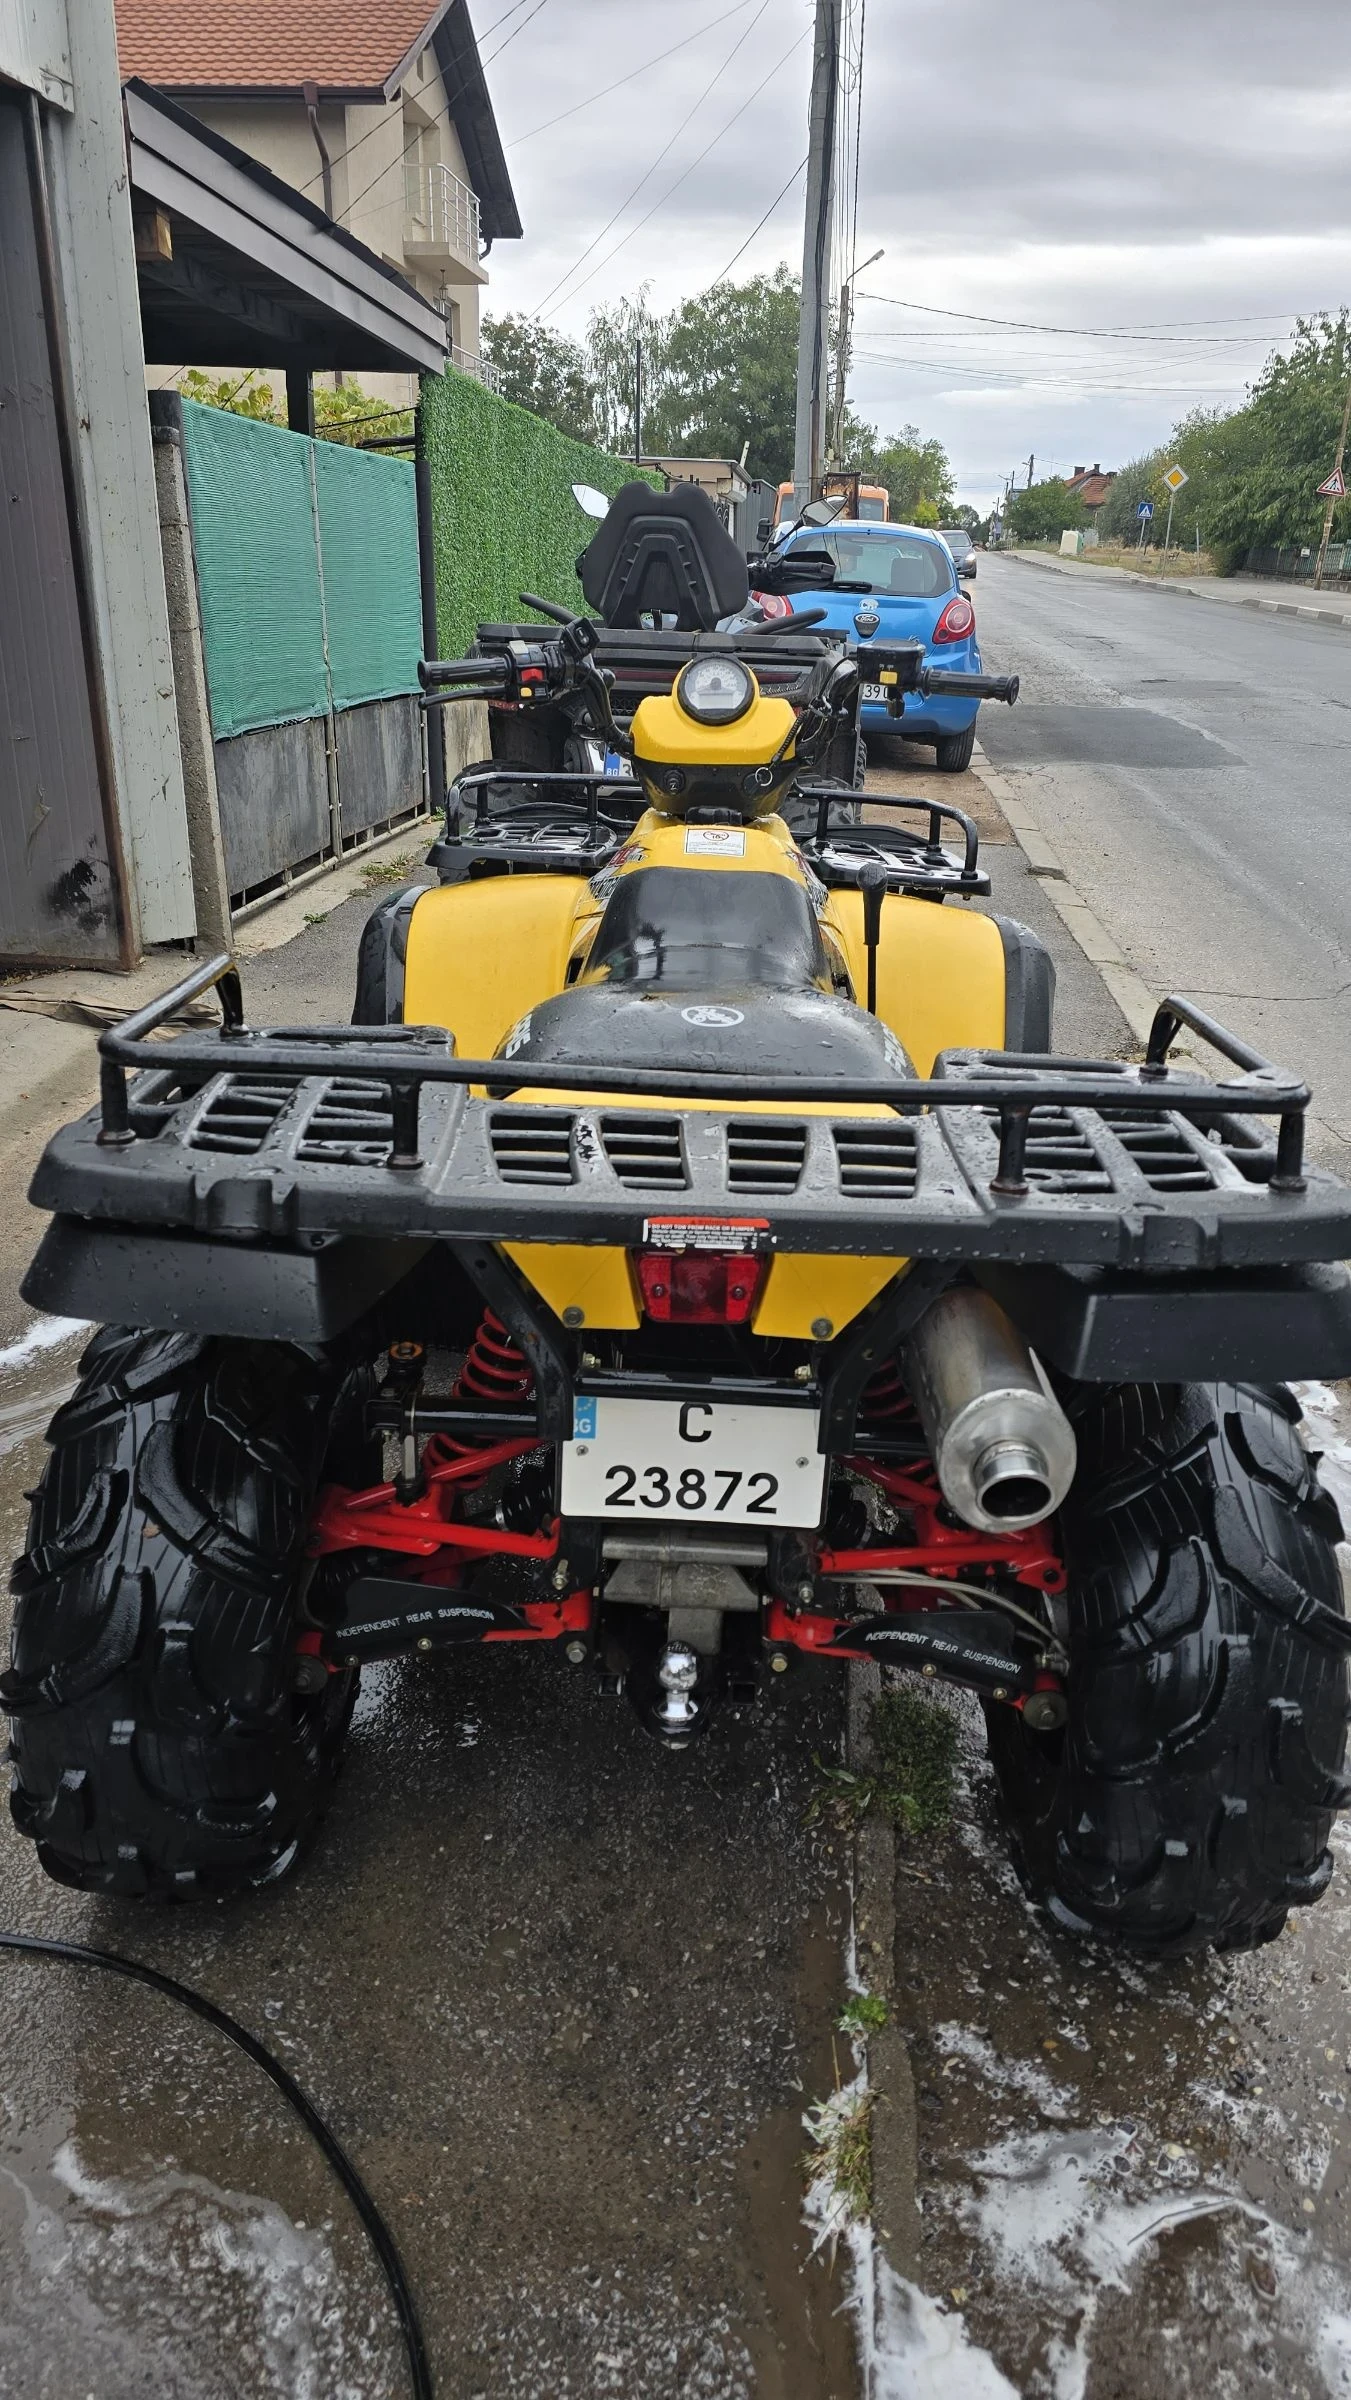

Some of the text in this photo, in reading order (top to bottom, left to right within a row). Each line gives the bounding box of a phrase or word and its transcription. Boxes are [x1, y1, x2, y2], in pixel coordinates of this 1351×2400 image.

[607, 767, 618, 776] BG
[678, 1401, 713, 1443] C
[604, 1465, 779, 1514] 23872
[336, 1607, 495, 1638] INDEPENDENT REAR SUSPENSION
[865, 1631, 1022, 1674] INDEPENDENT REAR SUSPENSION
